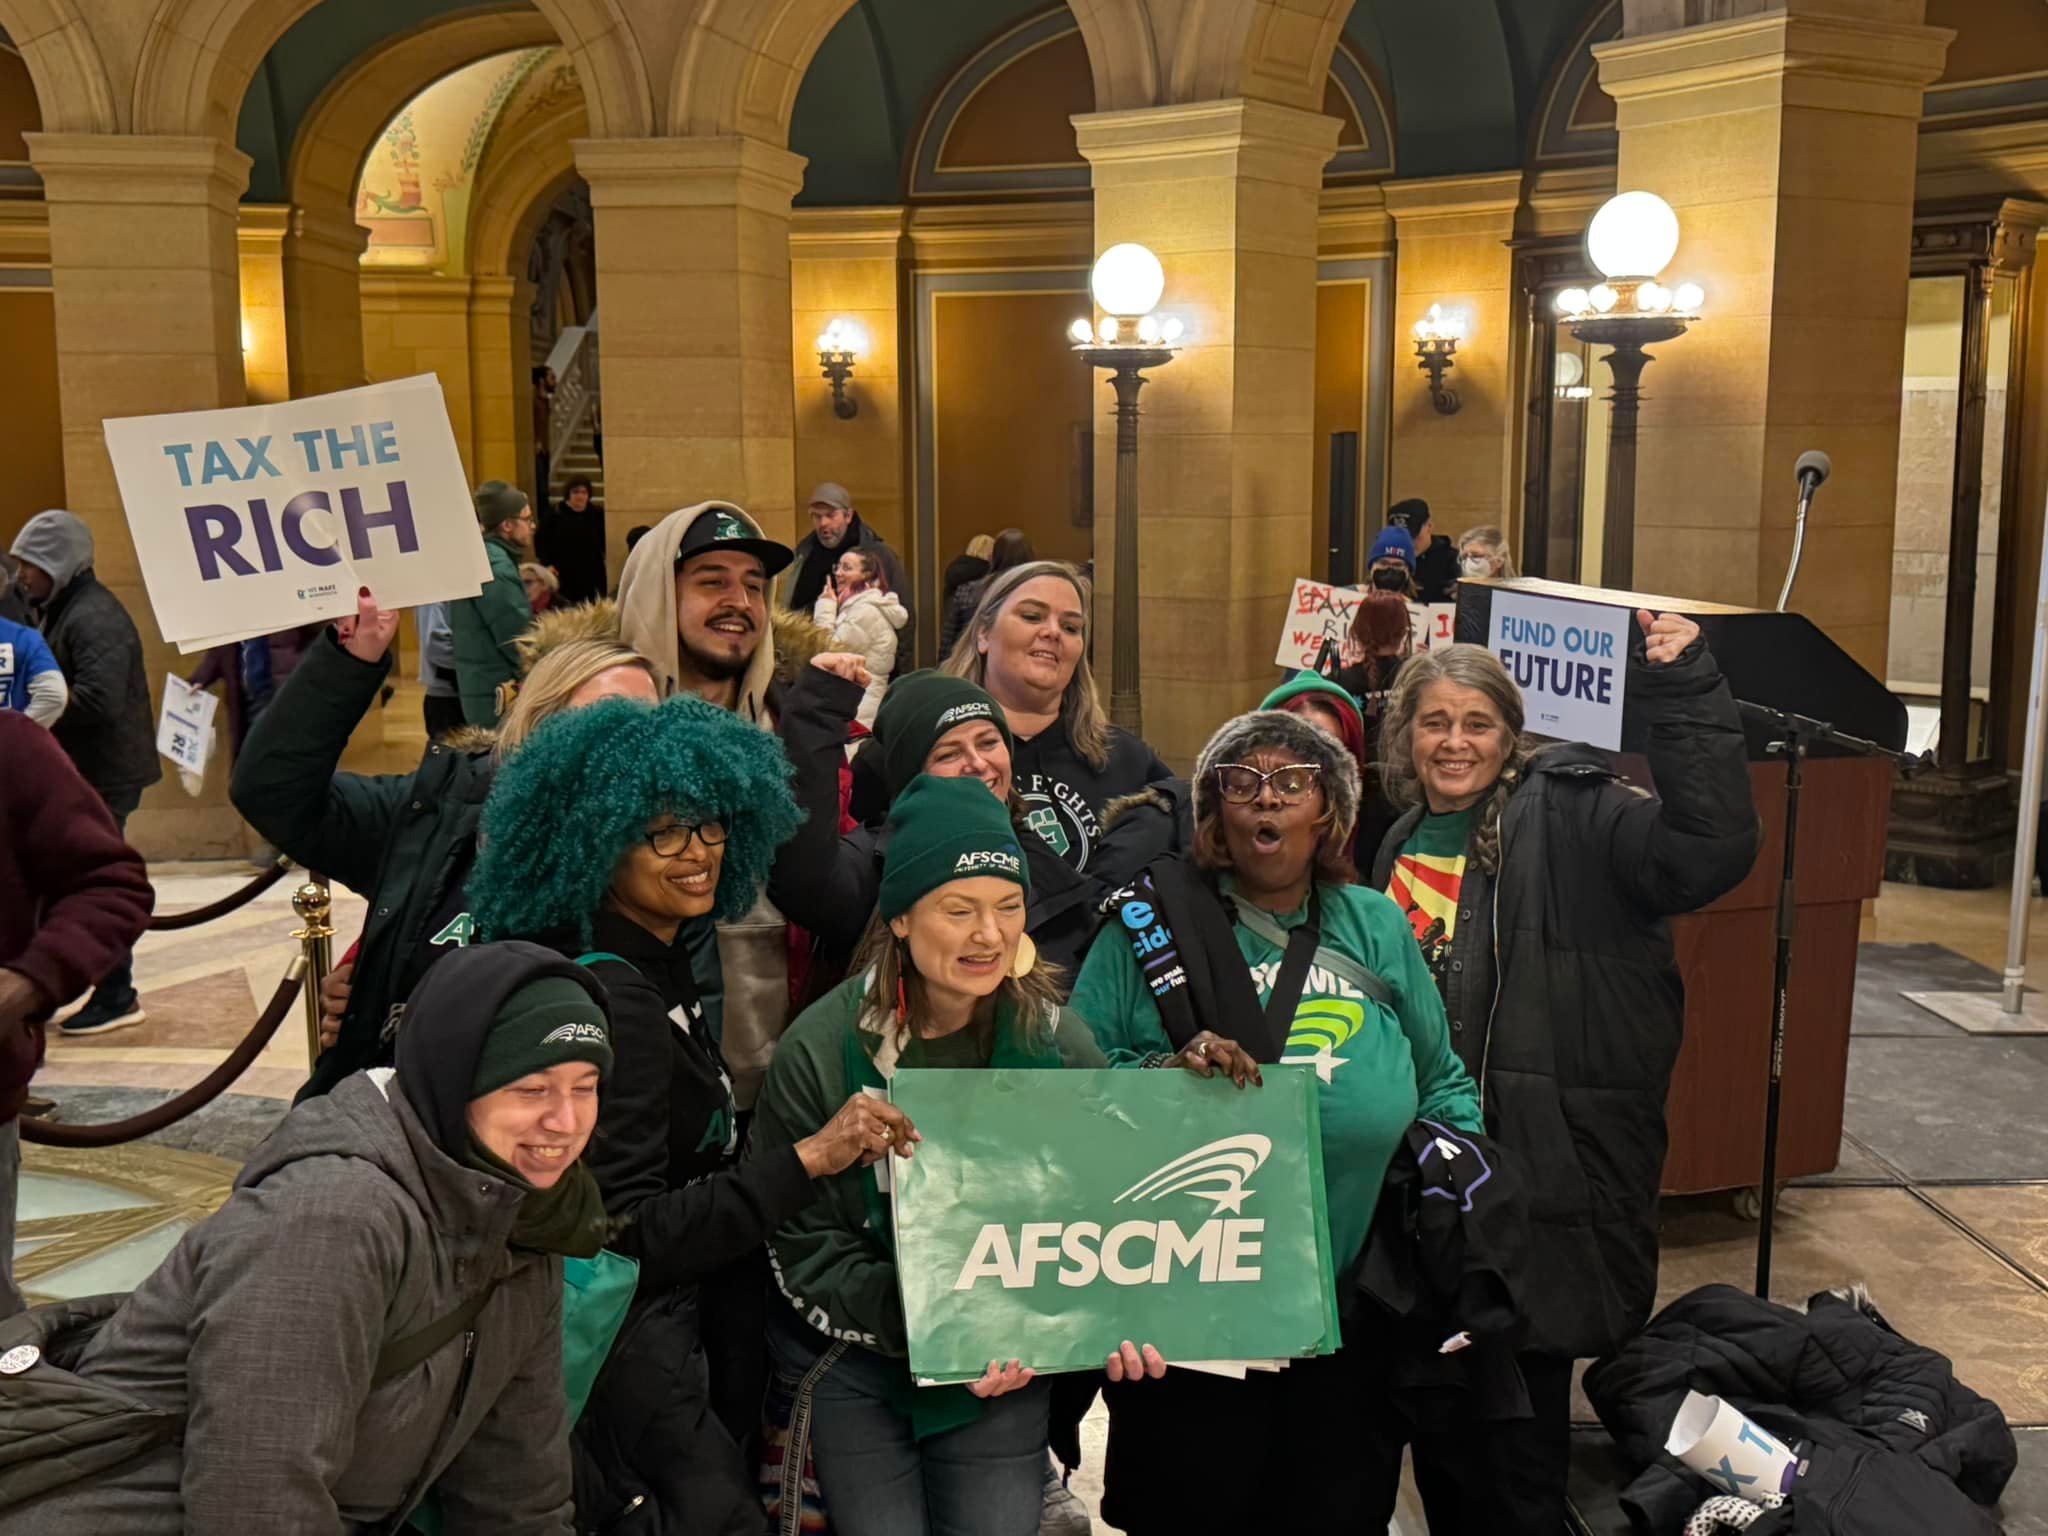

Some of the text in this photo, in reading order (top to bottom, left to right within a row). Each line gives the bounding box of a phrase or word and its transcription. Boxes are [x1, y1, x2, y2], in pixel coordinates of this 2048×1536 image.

[163, 421, 400, 487] TAX THE
[184, 480, 419, 581] RICH
[1501, 616, 1613, 658] FUND OUR
[1500, 649, 1613, 704] FUTURE
[1031, 774, 1102, 838] FGHTS
[955, 851, 1020, 870] AFSCME
[953, 1218, 1265, 1290] AFSCME
